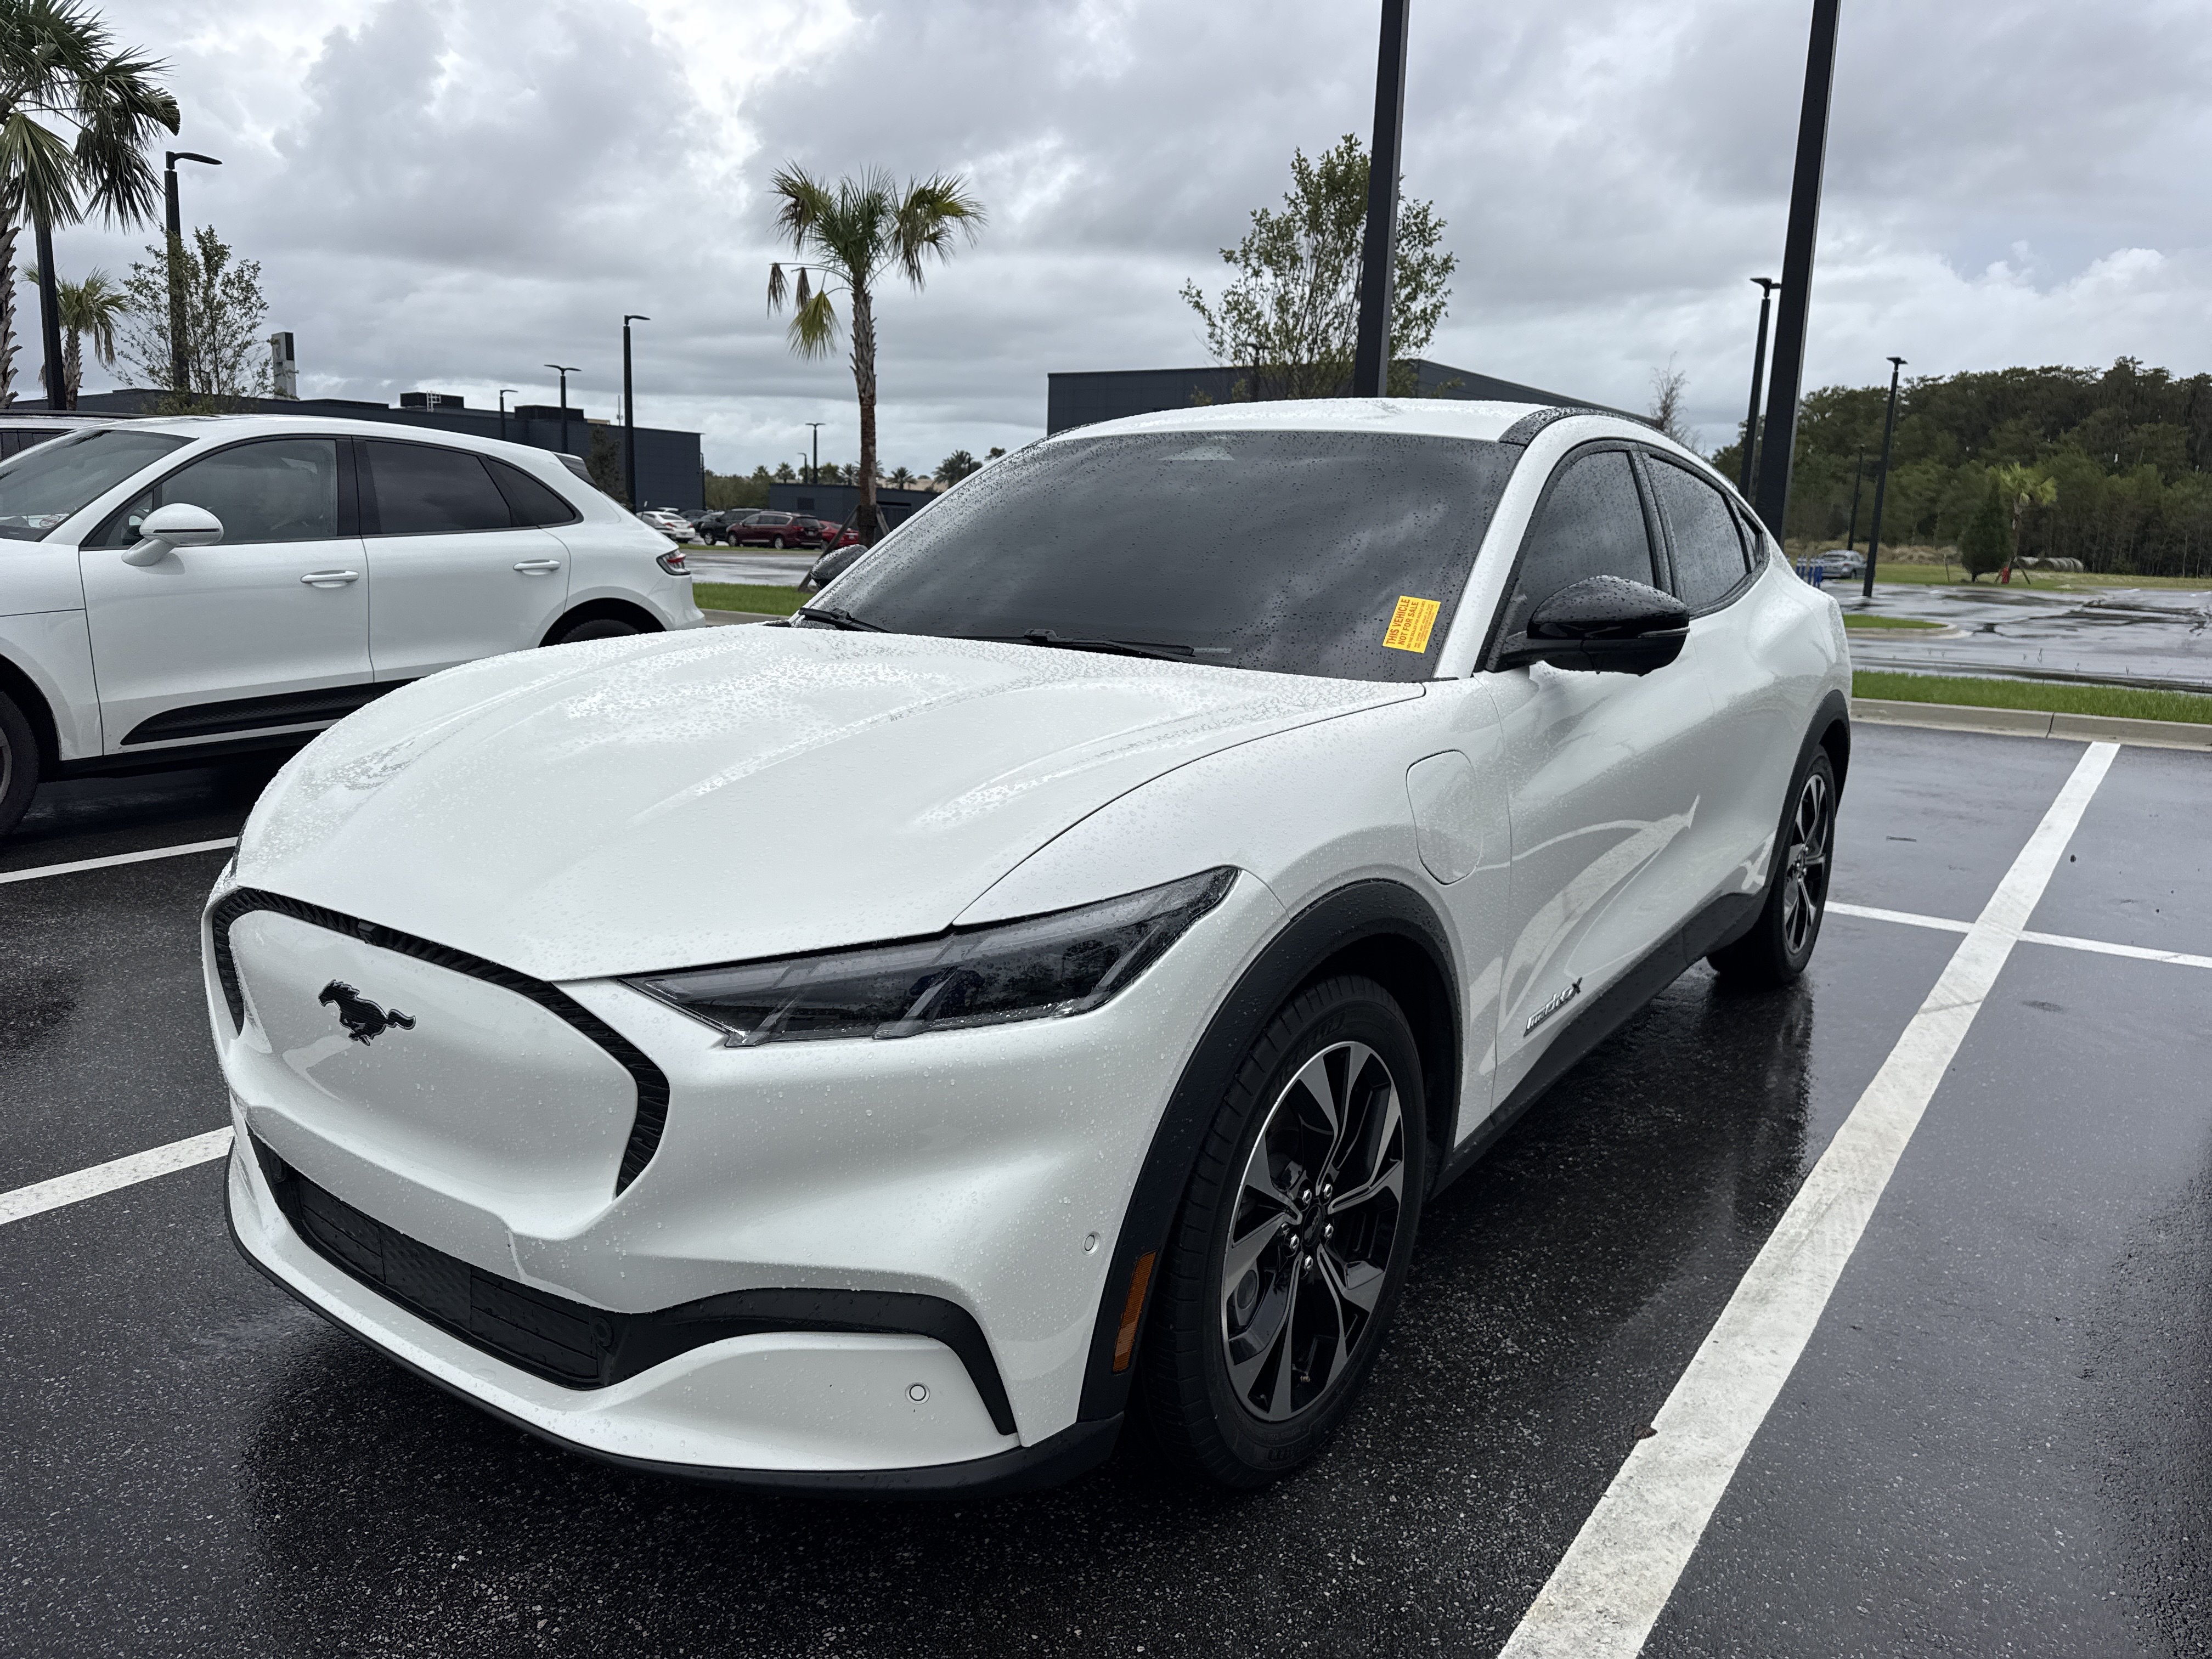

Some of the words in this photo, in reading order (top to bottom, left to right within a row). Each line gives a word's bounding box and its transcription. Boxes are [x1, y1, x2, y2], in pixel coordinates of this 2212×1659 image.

[1392, 599, 1410, 627] VEHICLE
[1398, 632, 1408, 645] NOT
[1403, 618, 1413, 631] FOR
[1408, 602, 1419, 617] SALE
[1385, 628, 1400, 645] THIS
